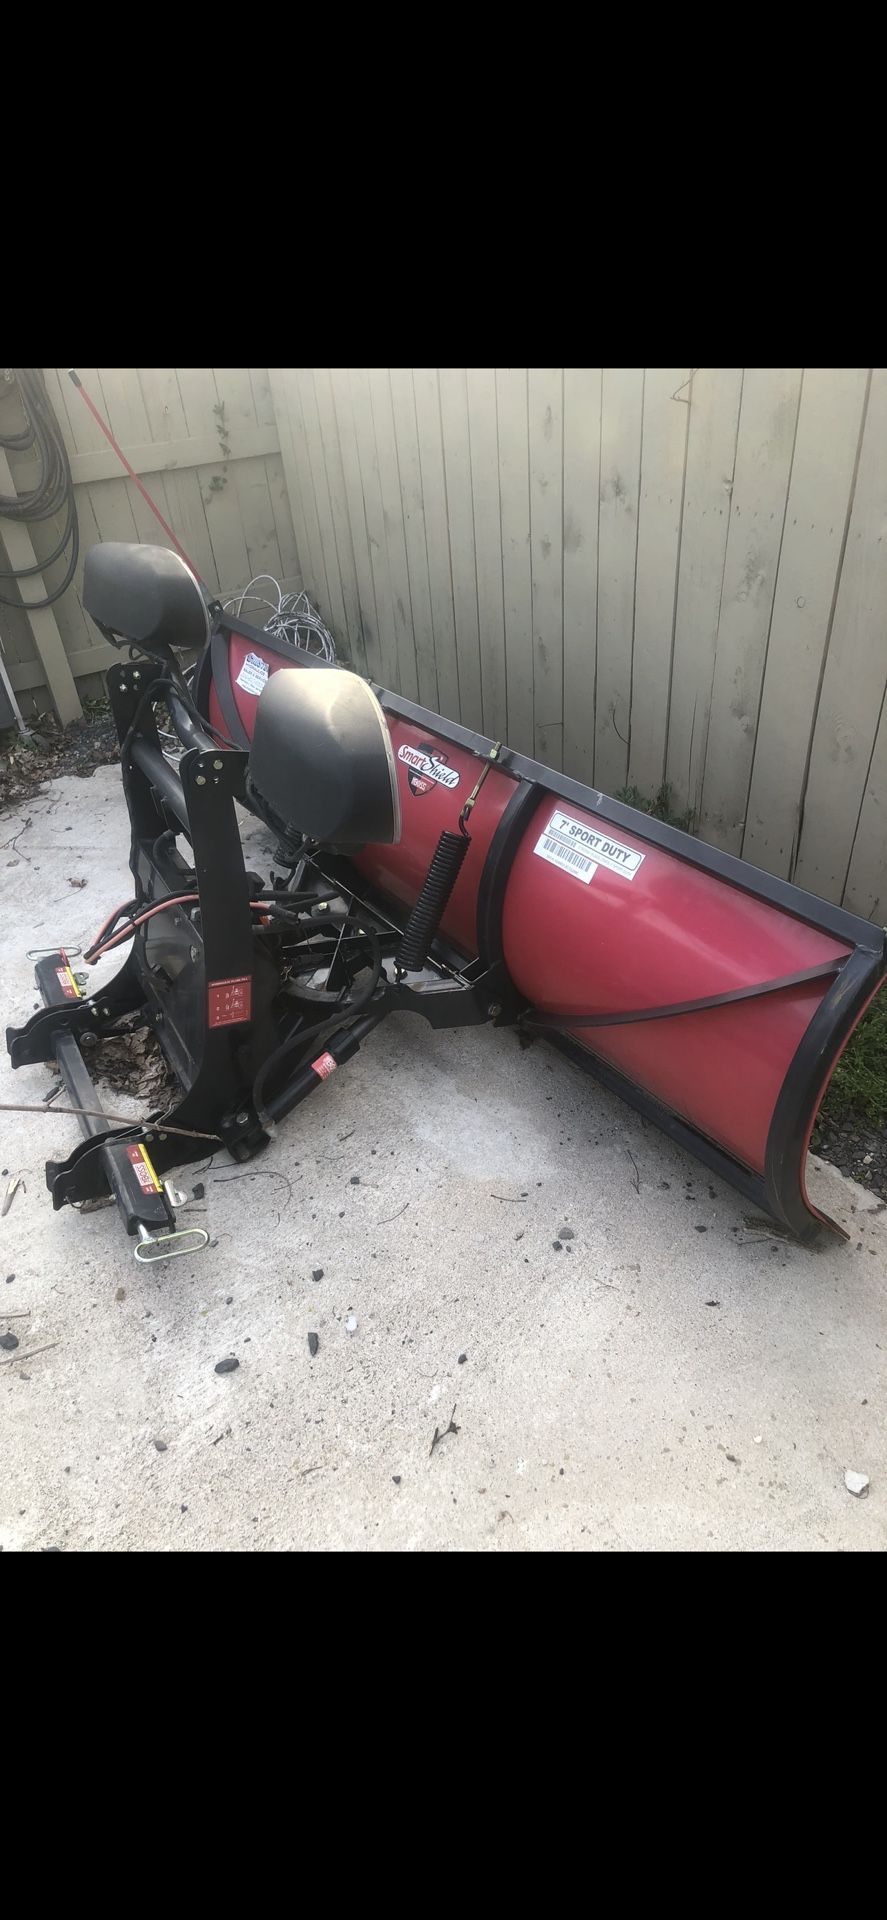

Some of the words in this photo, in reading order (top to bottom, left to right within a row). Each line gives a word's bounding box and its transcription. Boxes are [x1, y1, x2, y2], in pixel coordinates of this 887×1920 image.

[560, 820, 569, 829] 7'
[569, 825, 602, 848] SPORT
[601, 842, 631, 863] DUTY
